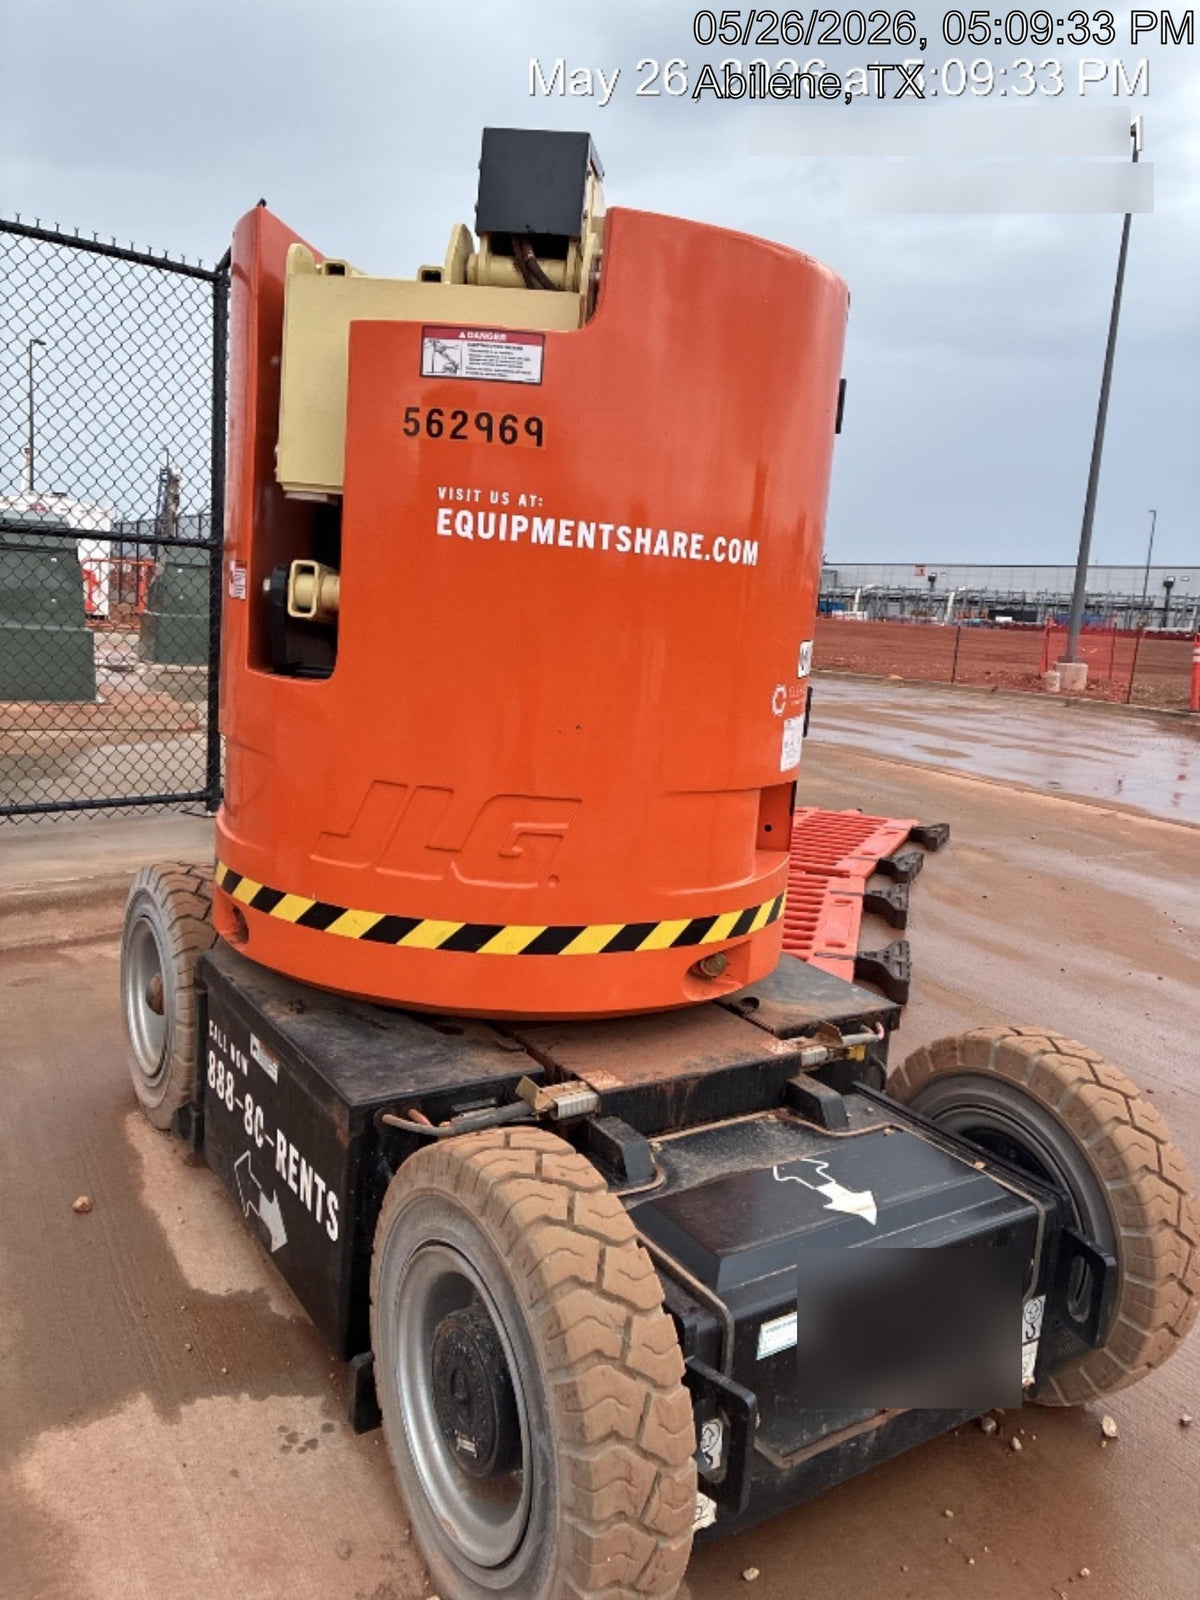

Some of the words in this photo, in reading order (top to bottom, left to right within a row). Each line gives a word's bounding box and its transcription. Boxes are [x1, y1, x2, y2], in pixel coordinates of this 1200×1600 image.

[403, 406, 543, 447] 562969
[438, 487, 481, 502] VISIT
[490, 490, 510, 505] US
[518, 493, 544, 508] AT:
[436, 507, 759, 567] EQUIPMENTSHARE.COM
[208, 1019, 228, 1054] CALL
[230, 1042, 249, 1077] NOW
[207, 1050, 339, 1242] 888-8C-RENTS
